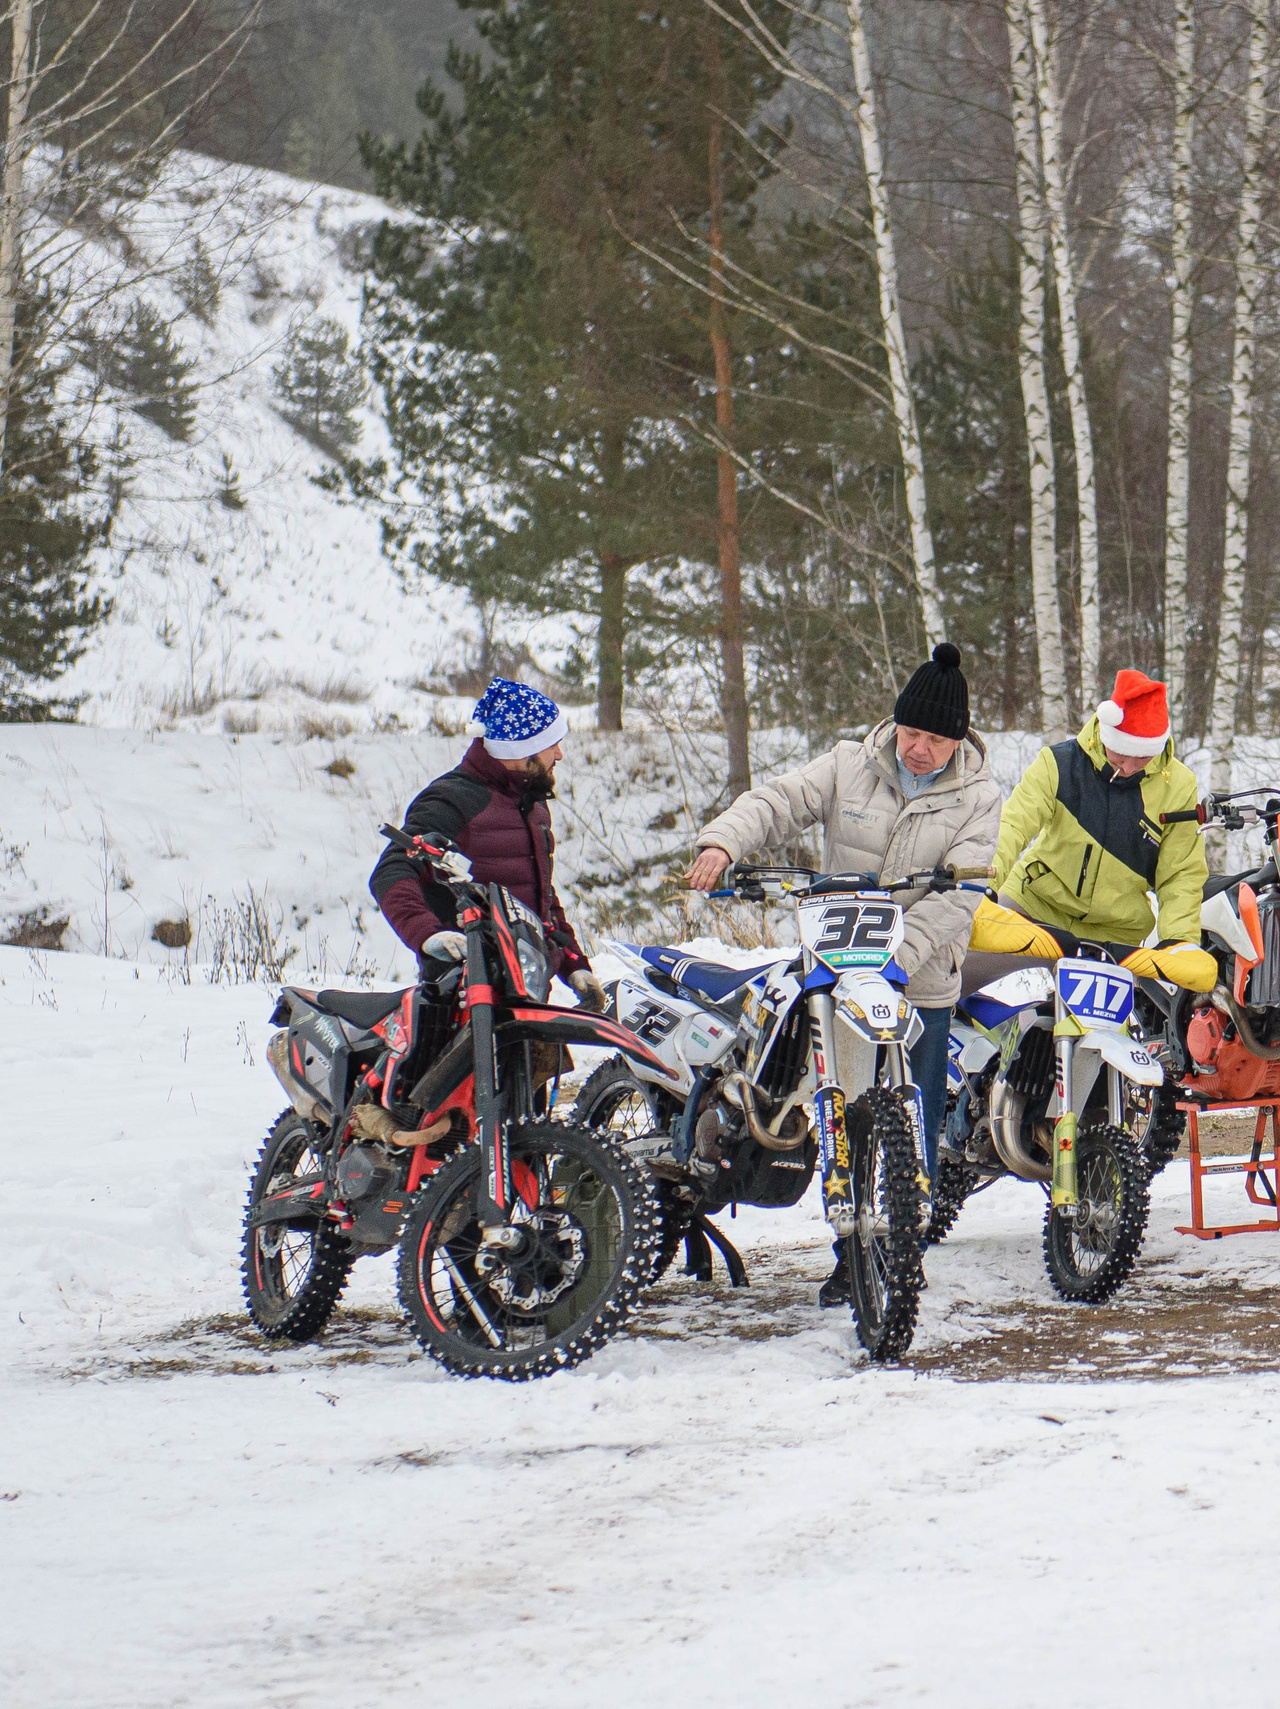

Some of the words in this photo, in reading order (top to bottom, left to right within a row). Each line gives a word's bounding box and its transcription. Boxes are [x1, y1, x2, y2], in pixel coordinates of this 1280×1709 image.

[811, 904, 898, 953] 32
[842, 953, 885, 962] MOTOREX
[1066, 972, 1131, 1013] 717
[620, 999, 684, 1048] 32
[1092, 1009, 1117, 1020] MEZIN
[826, 1133, 835, 1160] DRINK
[832, 1092, 849, 1168] ROCSTAR
[910, 1126, 922, 1159] ENERGY
